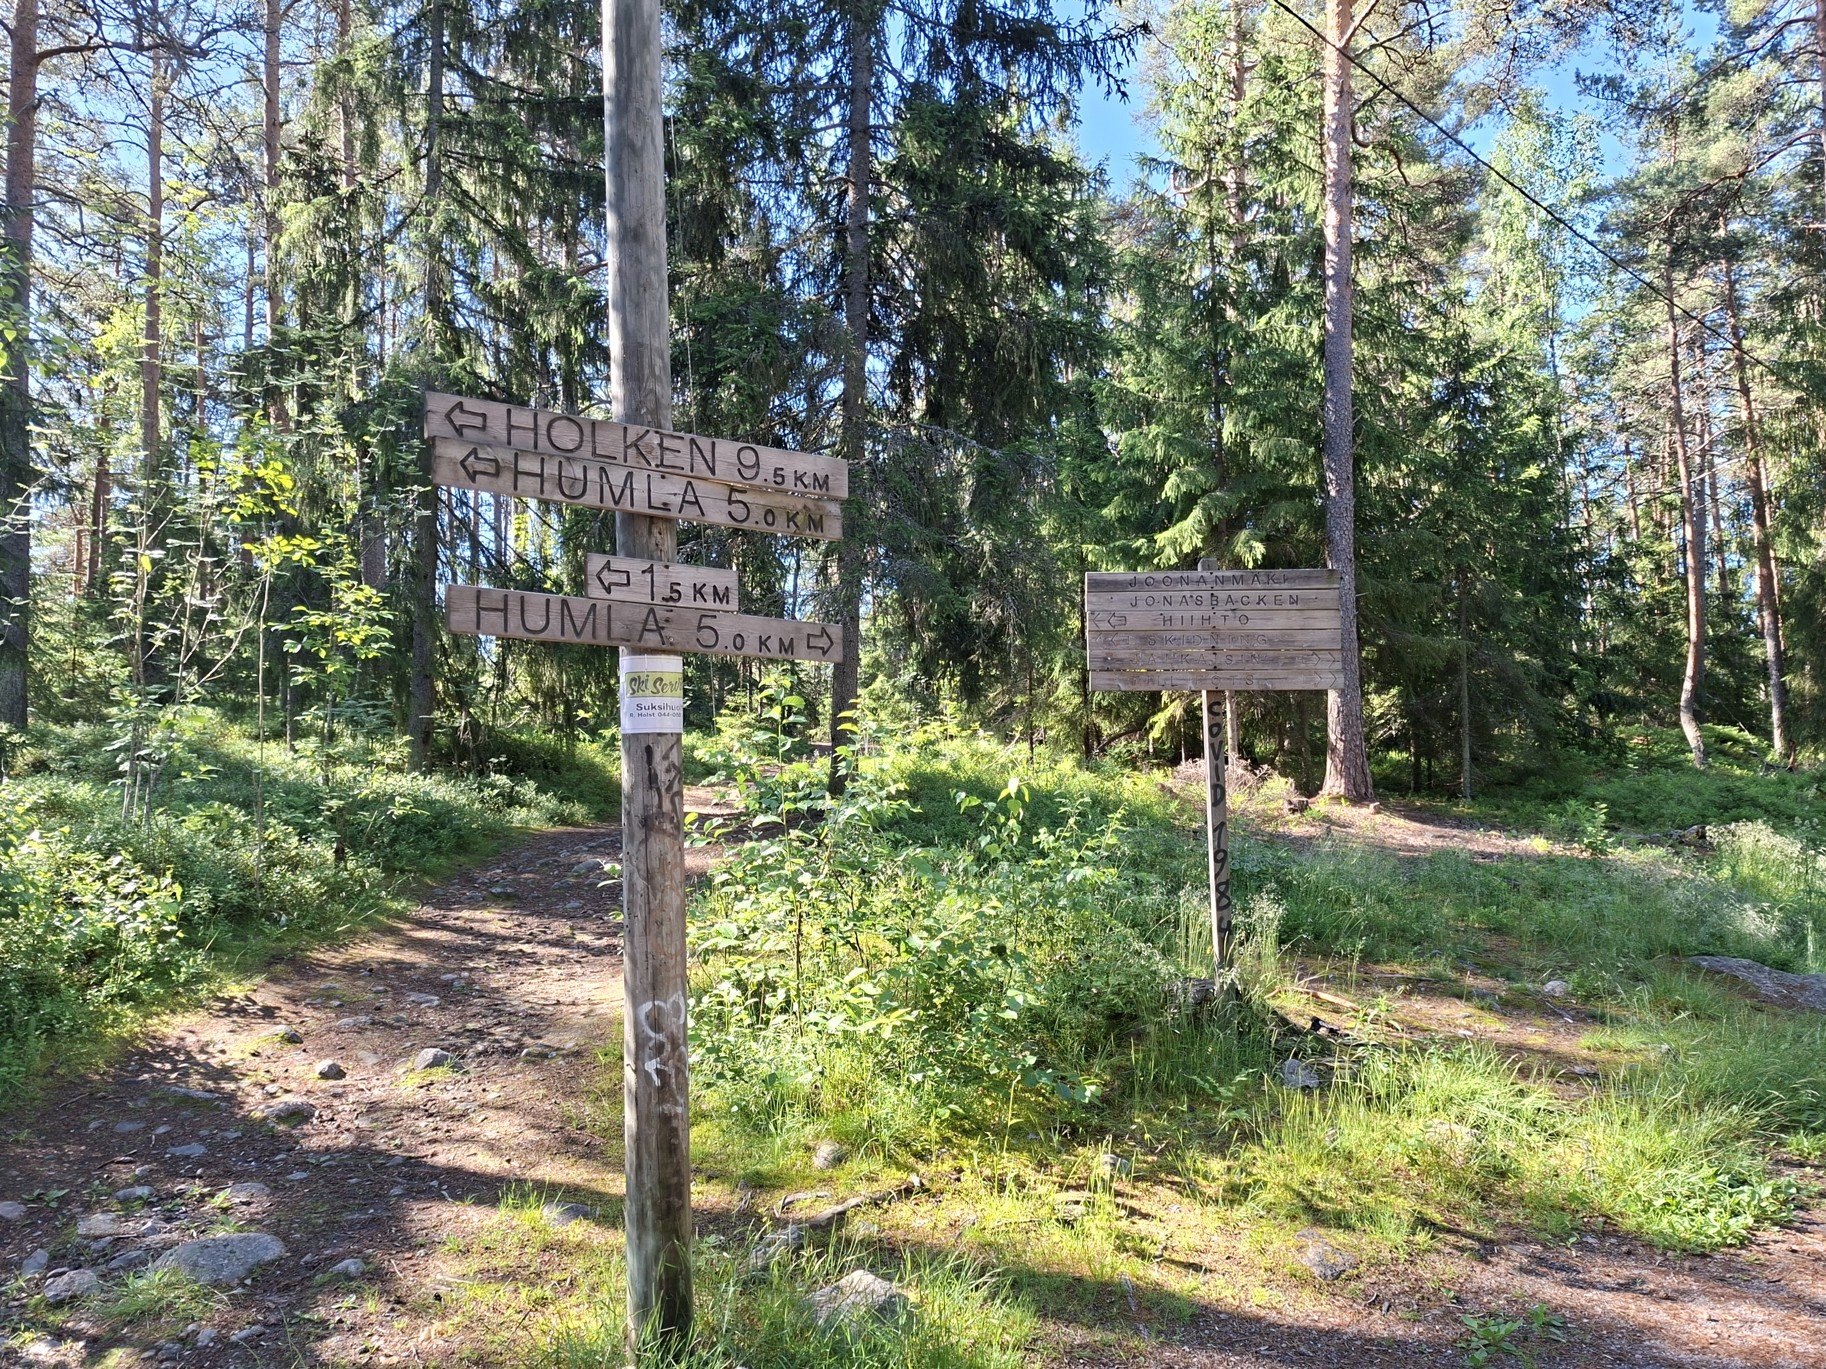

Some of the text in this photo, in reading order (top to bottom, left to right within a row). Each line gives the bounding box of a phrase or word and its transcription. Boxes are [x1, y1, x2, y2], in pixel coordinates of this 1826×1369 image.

[506, 409, 717, 476] HOLKEN
[793, 469, 831, 492] KM
[513, 451, 706, 517] HUMLA
[786, 510, 825, 533] KM
[693, 582, 730, 605] KM
[1130, 593, 1299, 607] JONASBACKEN
[476, 590, 667, 646] HUMLA
[758, 635, 796, 656] KM
[1163, 614, 1250, 627] HIIHTO
[629, 674, 649, 696] Ski
[1207, 701, 1226, 807] COVID
